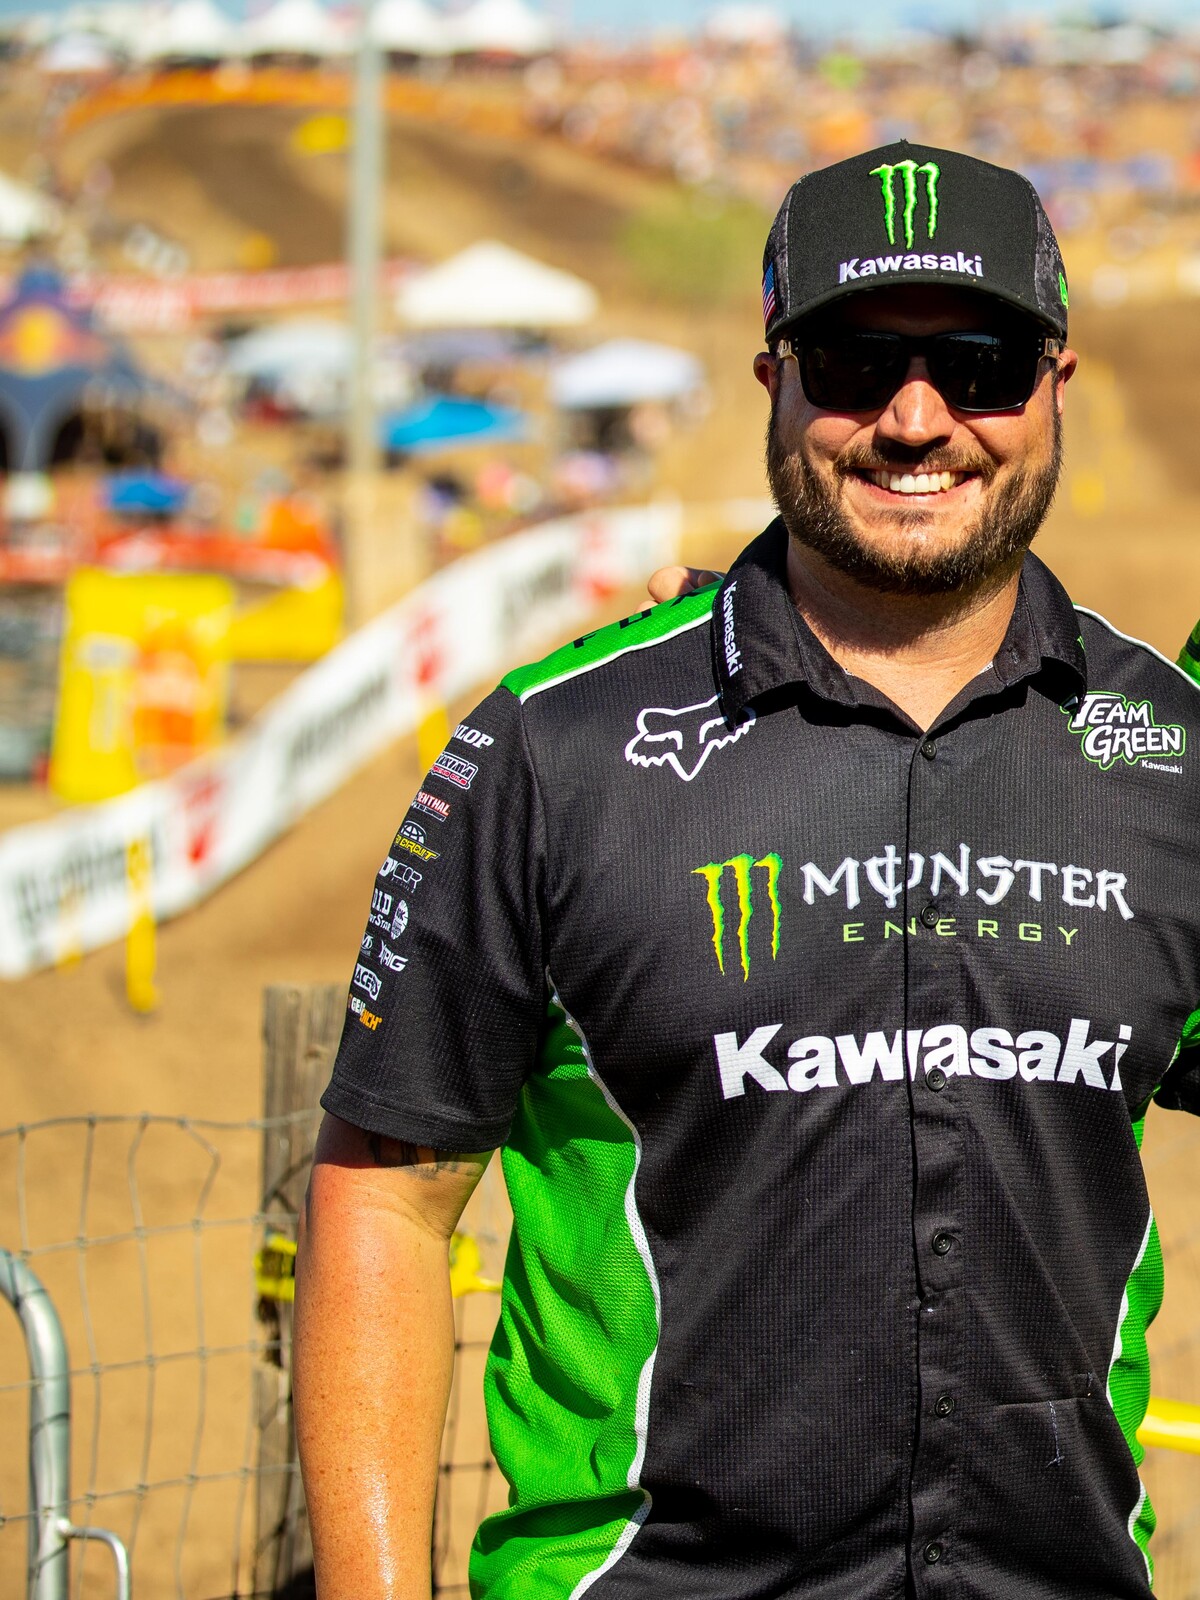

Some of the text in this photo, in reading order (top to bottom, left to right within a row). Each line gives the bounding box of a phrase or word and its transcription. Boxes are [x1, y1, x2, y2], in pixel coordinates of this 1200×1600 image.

[838, 251, 984, 283] Kawasaki
[722, 580, 744, 677] Kawasaki
[1064, 693, 1151, 729] TEAM
[1083, 724, 1181, 764] GREEN
[1141, 759, 1183, 775] Kawasaki
[799, 842, 1135, 921] MONSTER
[842, 917, 1080, 946] ENERGY
[713, 1017, 1133, 1101] Kawasaki
